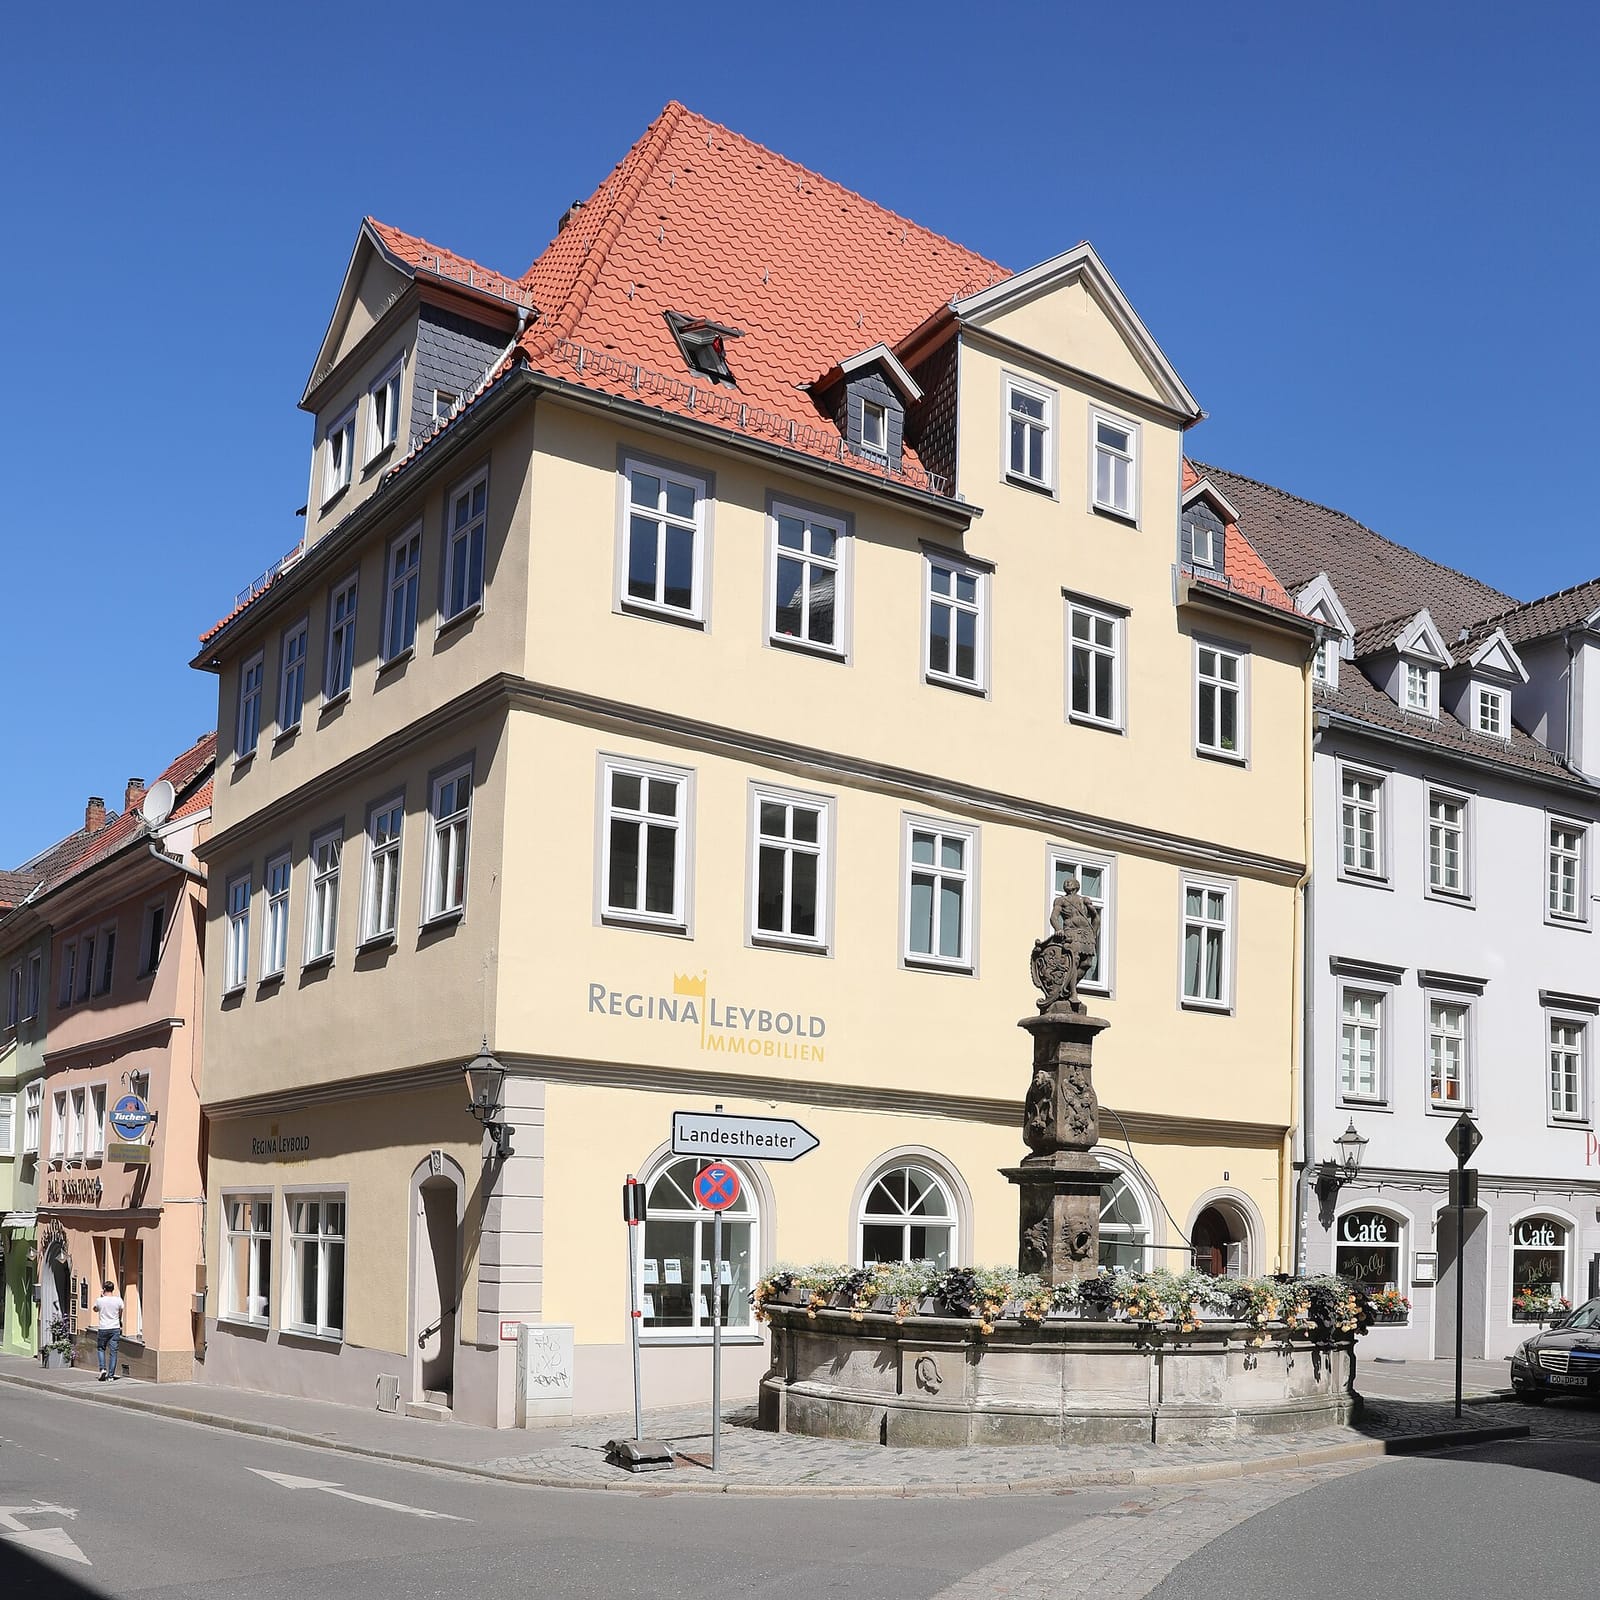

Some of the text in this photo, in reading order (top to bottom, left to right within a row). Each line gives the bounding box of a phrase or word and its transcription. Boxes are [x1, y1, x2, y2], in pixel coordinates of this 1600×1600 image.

[588, 982, 826, 1038] REGINA LEYBOLD
[114, 1112, 147, 1121] Tucher
[252, 1135, 310, 1155] REGINA LEYBOLD
[679, 1125, 796, 1149] Landestheater
[1343, 1215, 1387, 1242] Café
[1518, 1220, 1555, 1246] Café
[1351, 1254, 1385, 1280] Dolly
